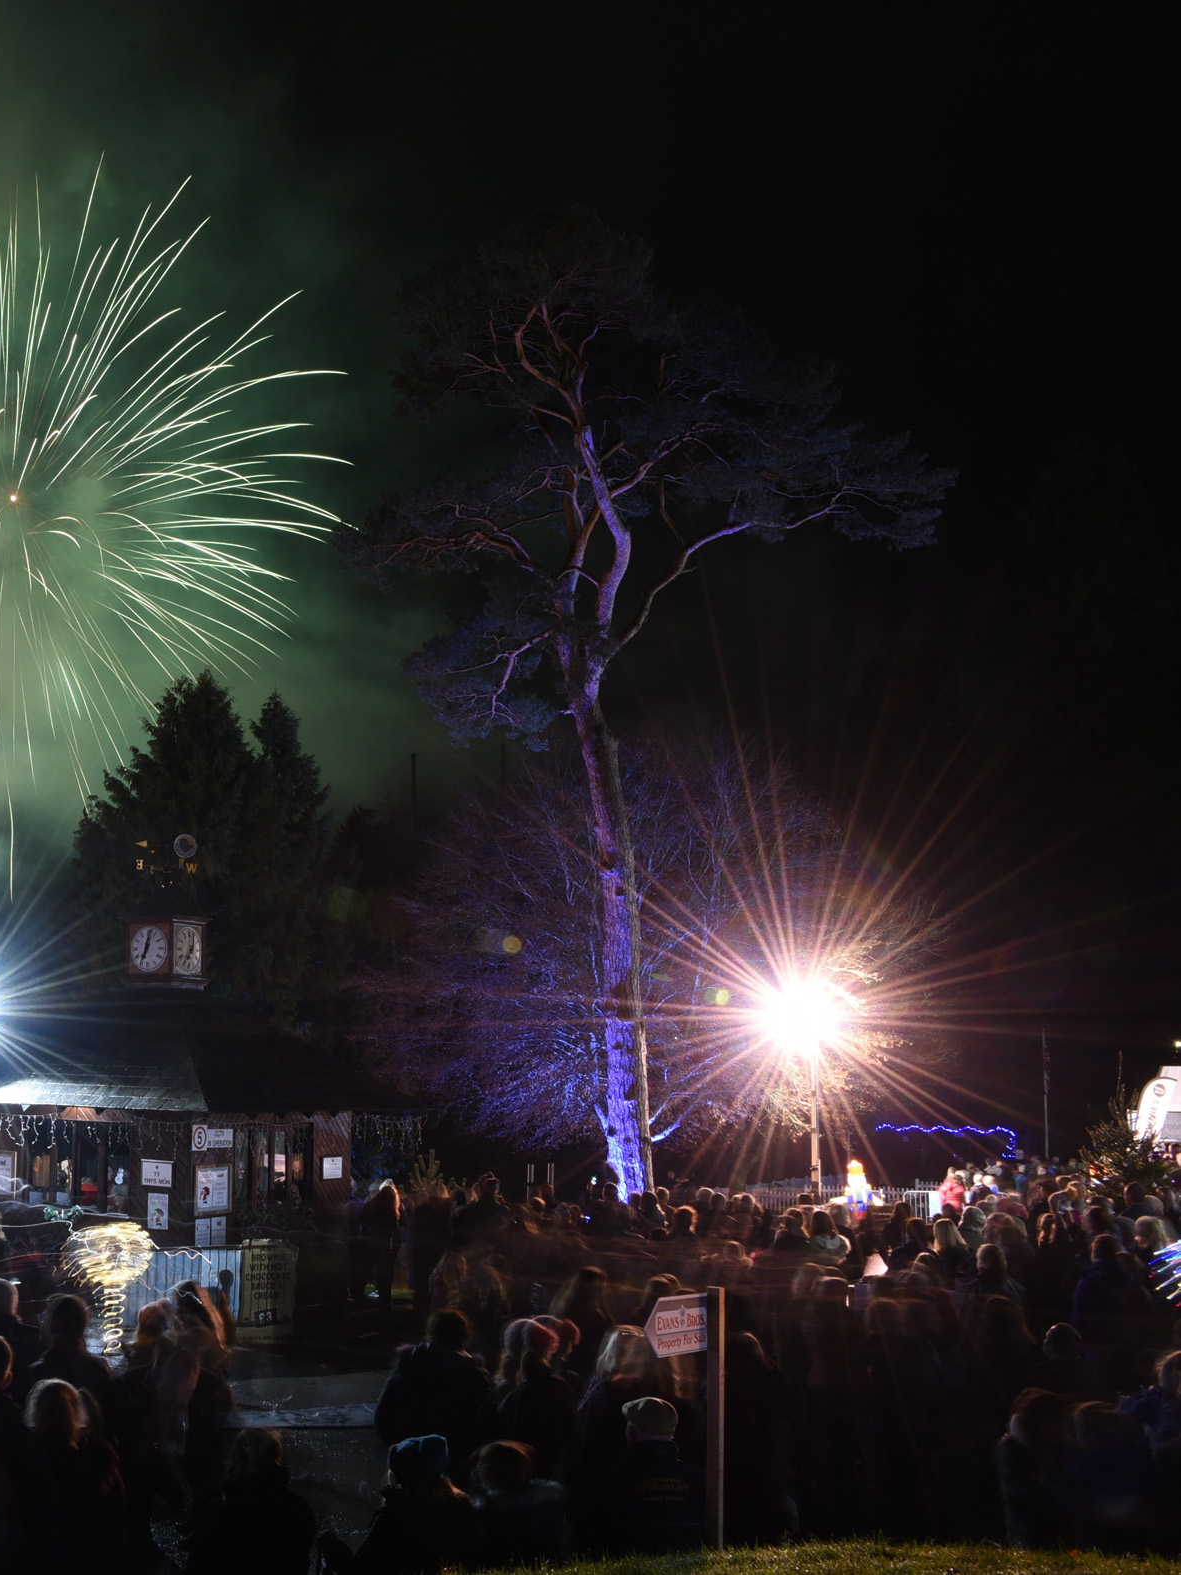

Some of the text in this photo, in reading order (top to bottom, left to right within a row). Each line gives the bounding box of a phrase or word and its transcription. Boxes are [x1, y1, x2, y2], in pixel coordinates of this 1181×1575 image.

[185, 863, 199, 874] W
[197, 1131, 202, 1145] 5
[251, 1253, 287, 1262] BROWNIE
[249, 1262, 288, 1271] WITH HOT
[245, 1272, 291, 1281] CHOCOLATE
[251, 1281, 276, 1290] SAUCE
[254, 1291, 280, 1300] CREAM
[259, 1311, 273, 1322] £3
[657, 1316, 679, 1331] EVANS
[657, 1333, 706, 1350] Property For Sale
